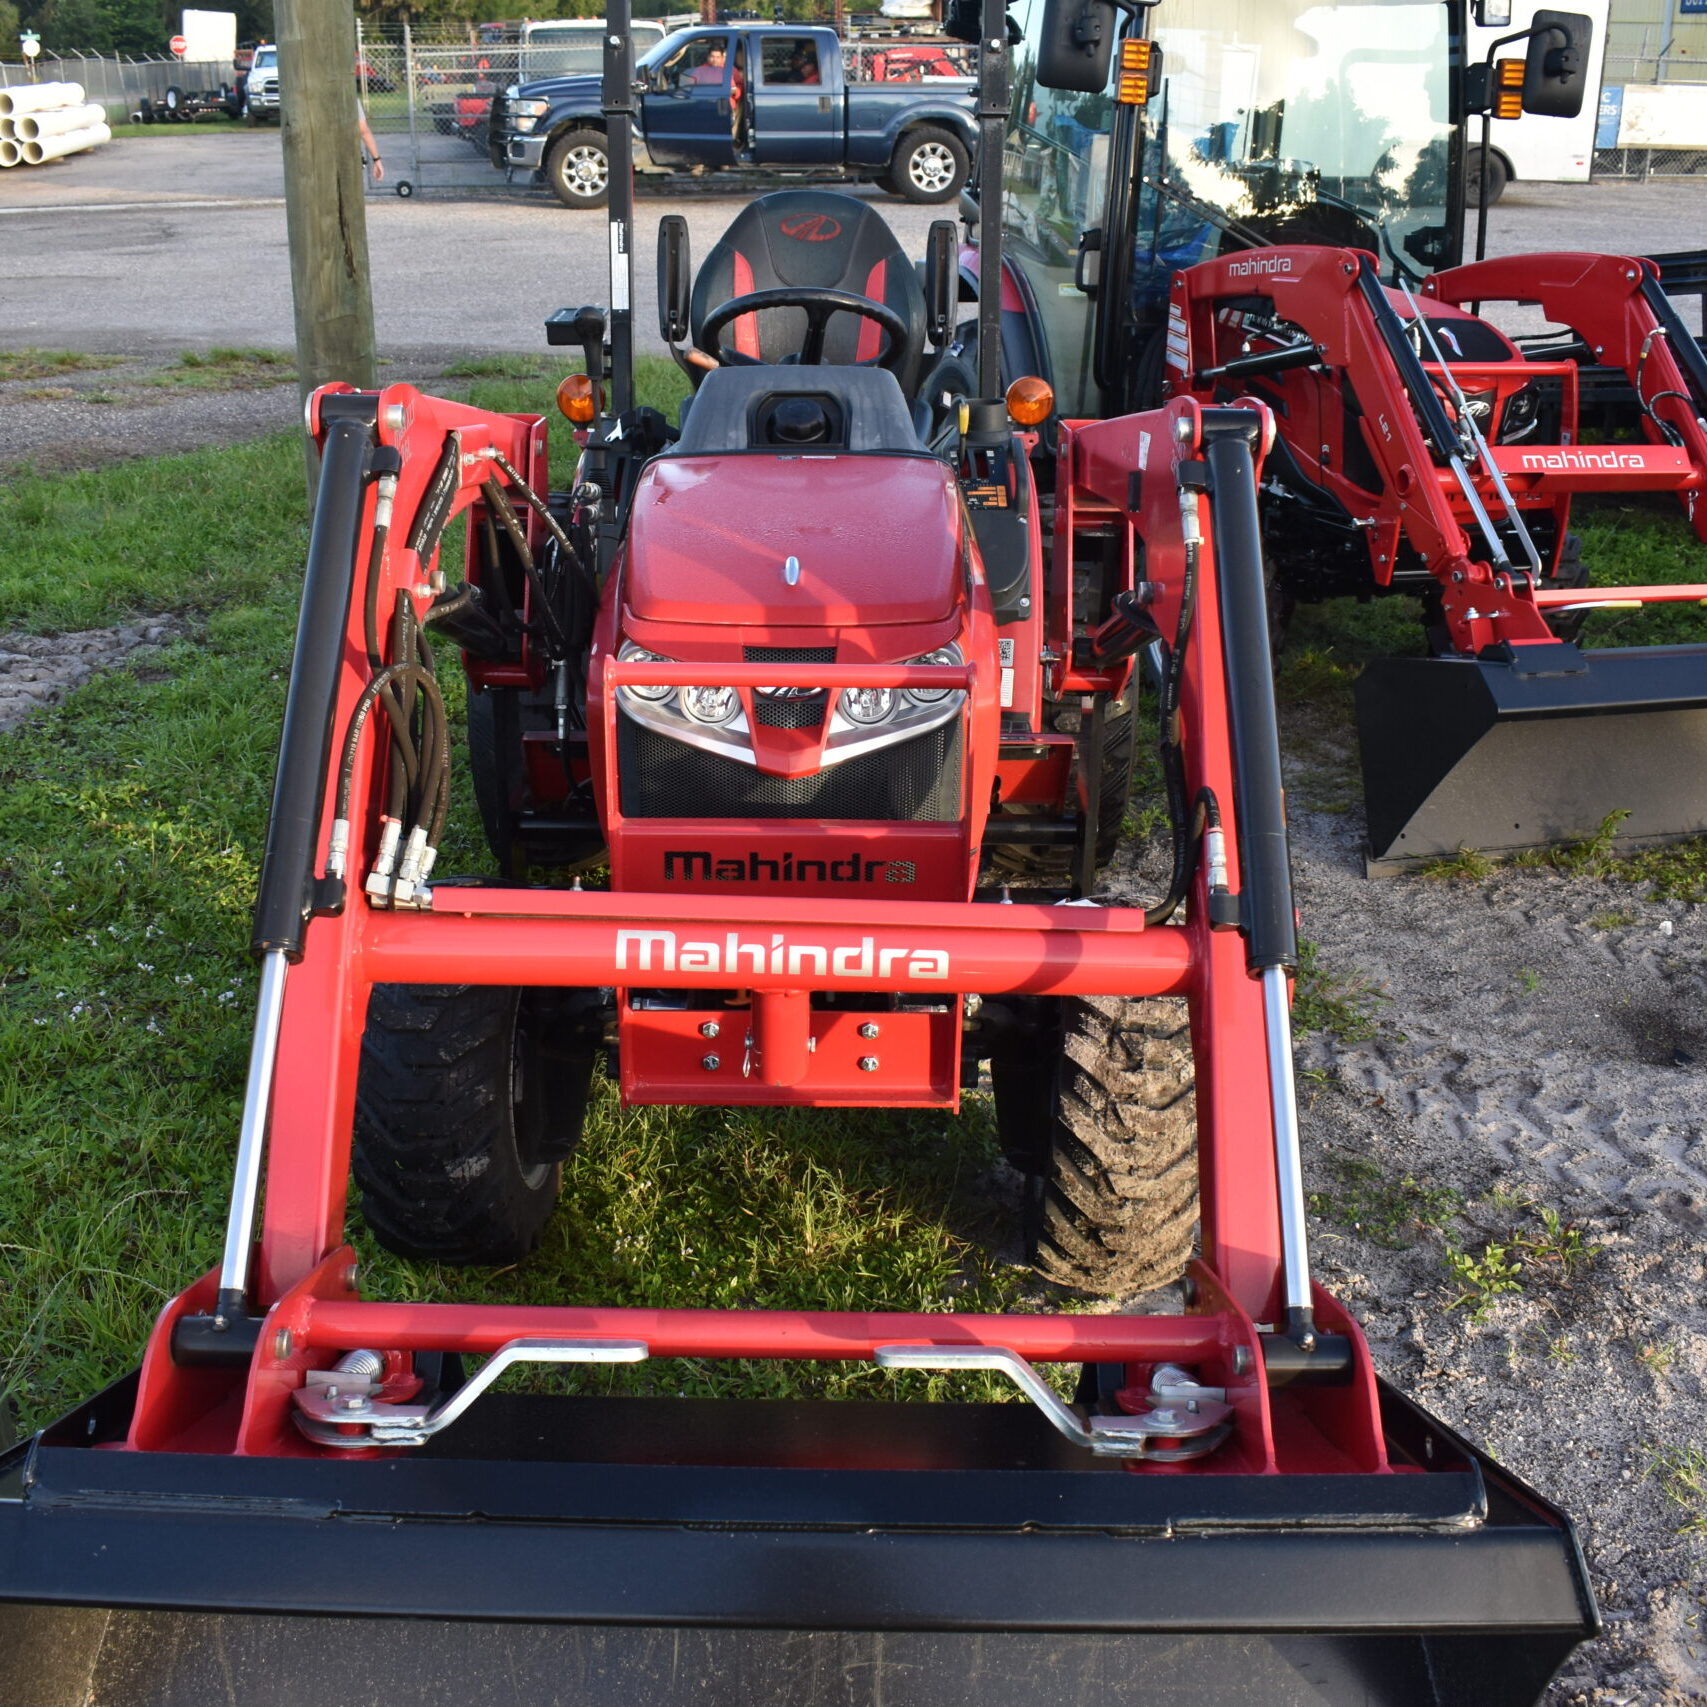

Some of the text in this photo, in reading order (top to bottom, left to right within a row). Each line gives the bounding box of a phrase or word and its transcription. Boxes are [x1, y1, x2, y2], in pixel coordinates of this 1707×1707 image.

[1229, 255, 1292, 277] mahindra
[1521, 451, 1645, 469] mahindra
[664, 851, 915, 883] Mahindra
[615, 929, 949, 979] Mahindra
